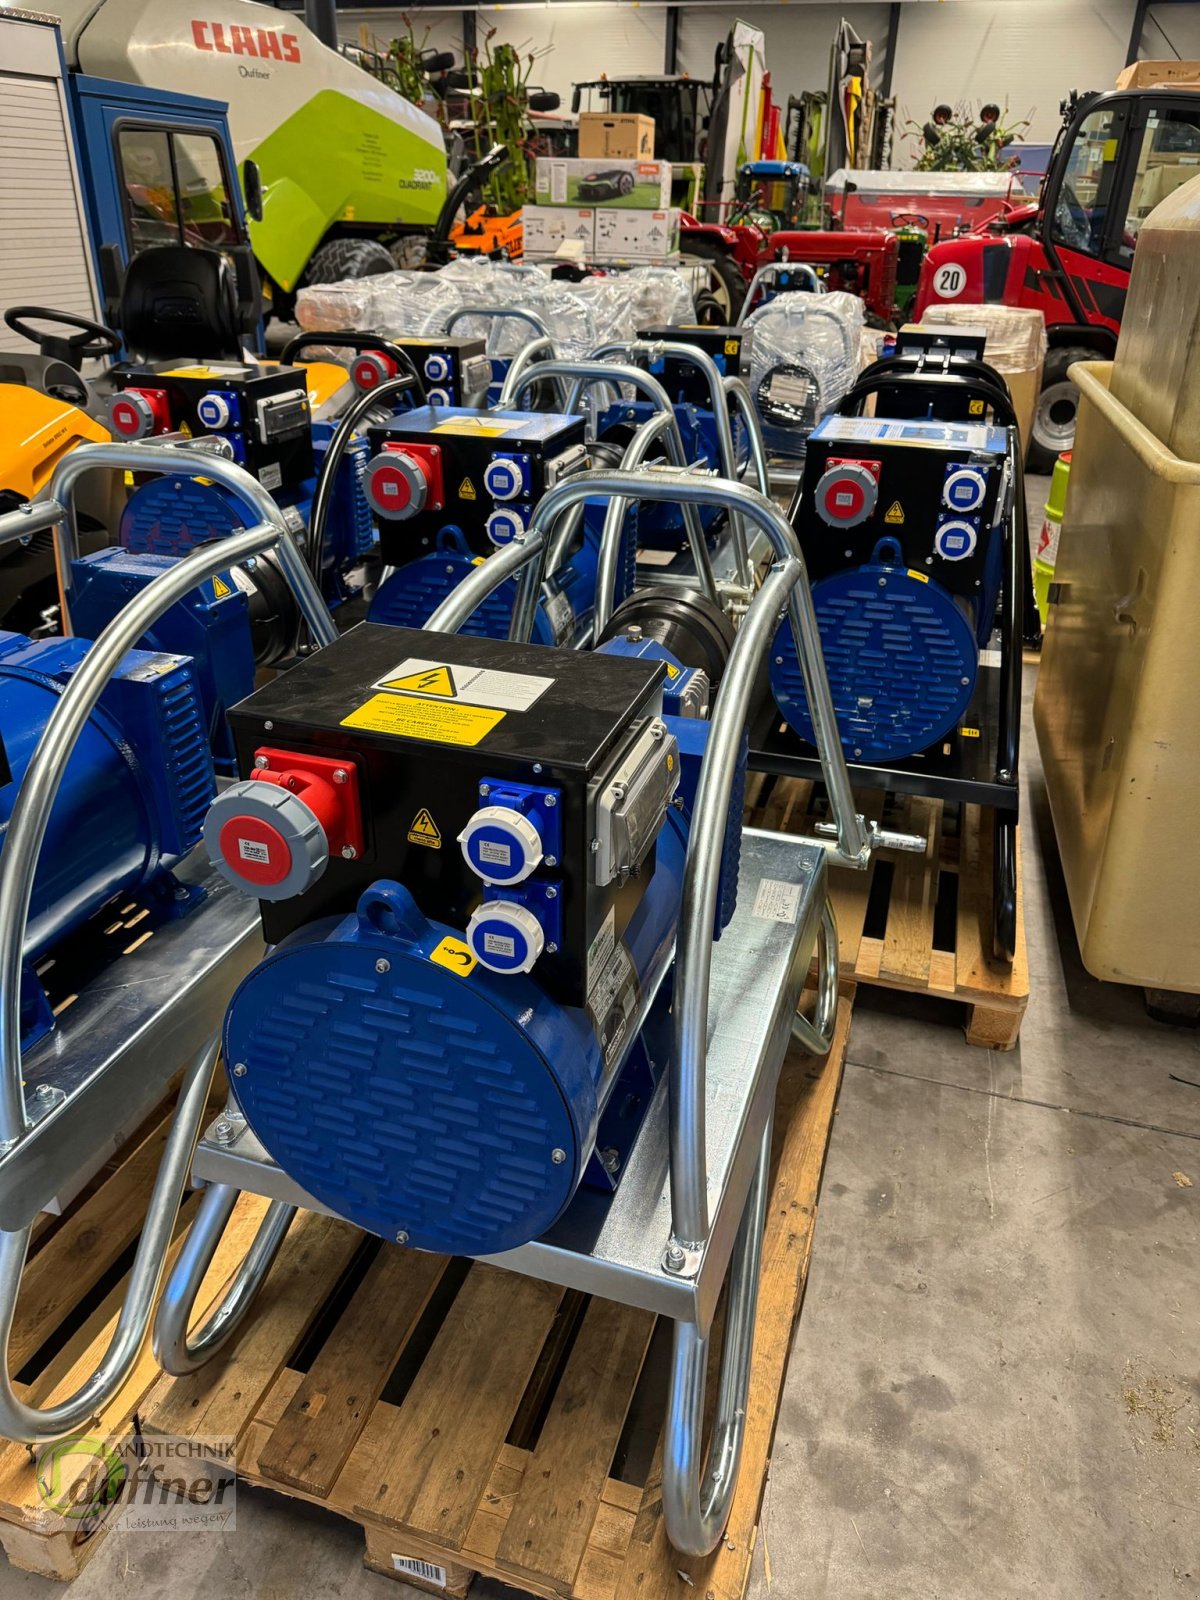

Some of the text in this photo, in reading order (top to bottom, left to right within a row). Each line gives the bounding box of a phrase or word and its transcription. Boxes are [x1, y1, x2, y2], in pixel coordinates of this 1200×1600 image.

[190, 19, 301, 64] CLAAS
[940, 270, 960, 291] 20
[416, 702, 456, 711] ATTENTION
